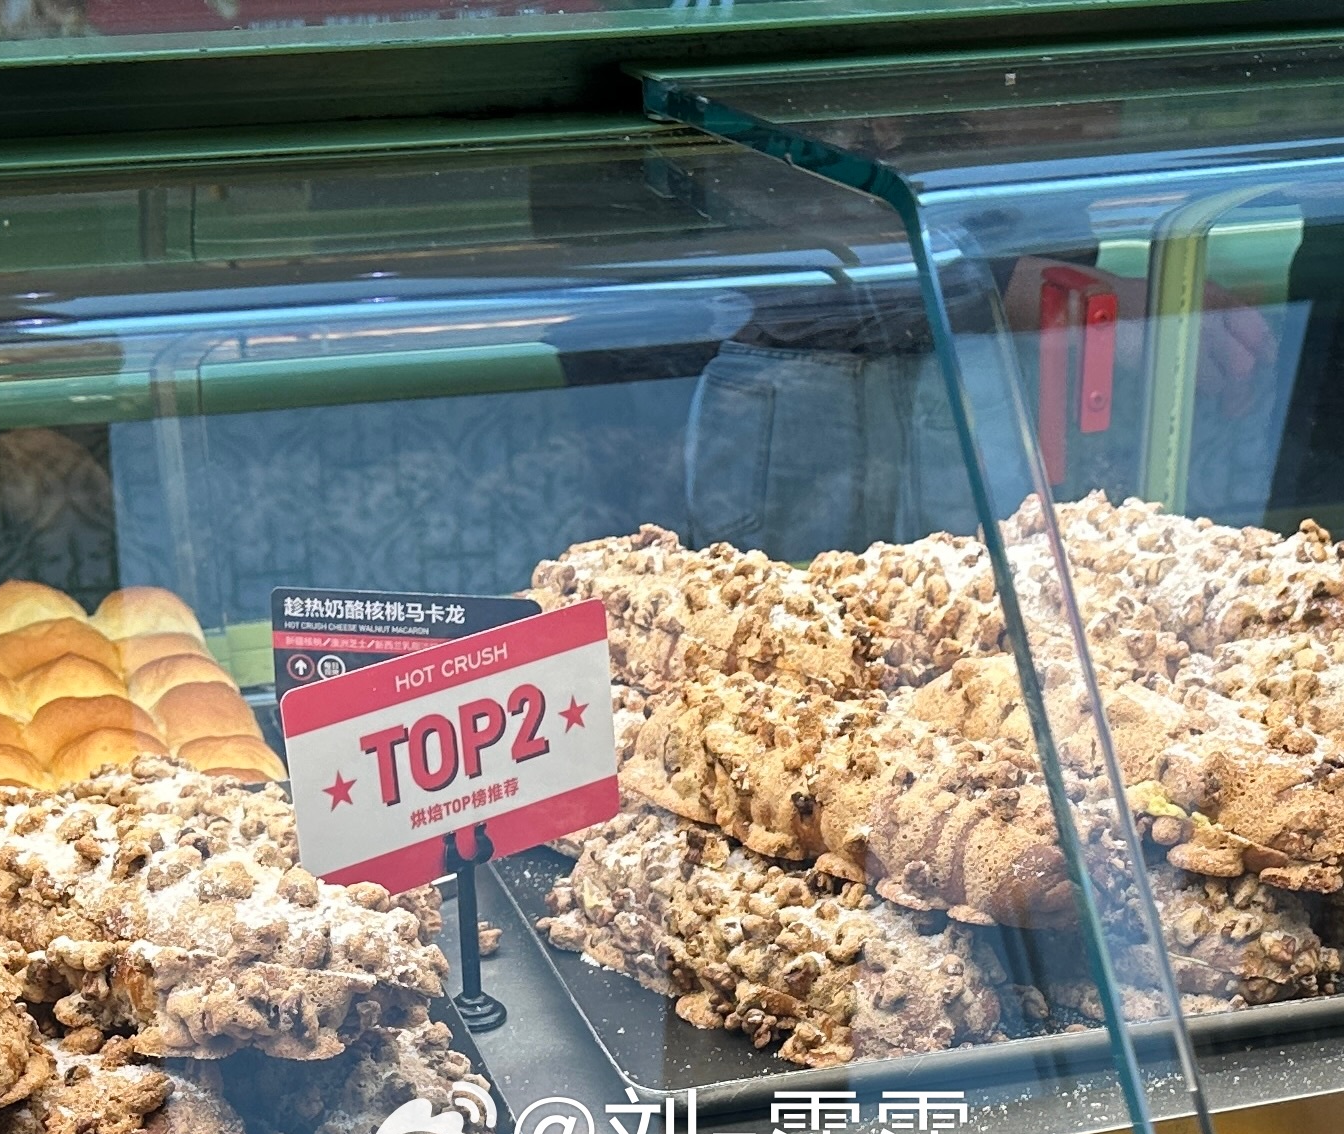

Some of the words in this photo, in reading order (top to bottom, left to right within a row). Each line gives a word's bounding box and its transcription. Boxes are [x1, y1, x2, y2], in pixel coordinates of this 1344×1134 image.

[283, 596, 466, 625] 趁热奶酪核桃马卡龙
[284, 621, 299, 630] HOT
[300, 621, 327, 631] CRUSH
[328, 623, 357, 632] CHEESE
[358, 624, 391, 633] WALNUT
[391, 625, 430, 635] MACARON
[394, 664, 436, 692] HOT
[440, 642, 509, 677] CRUSH
[359, 683, 550, 807] TOP2
[410, 777, 520, 829] 烘焙TOP榜推荐
